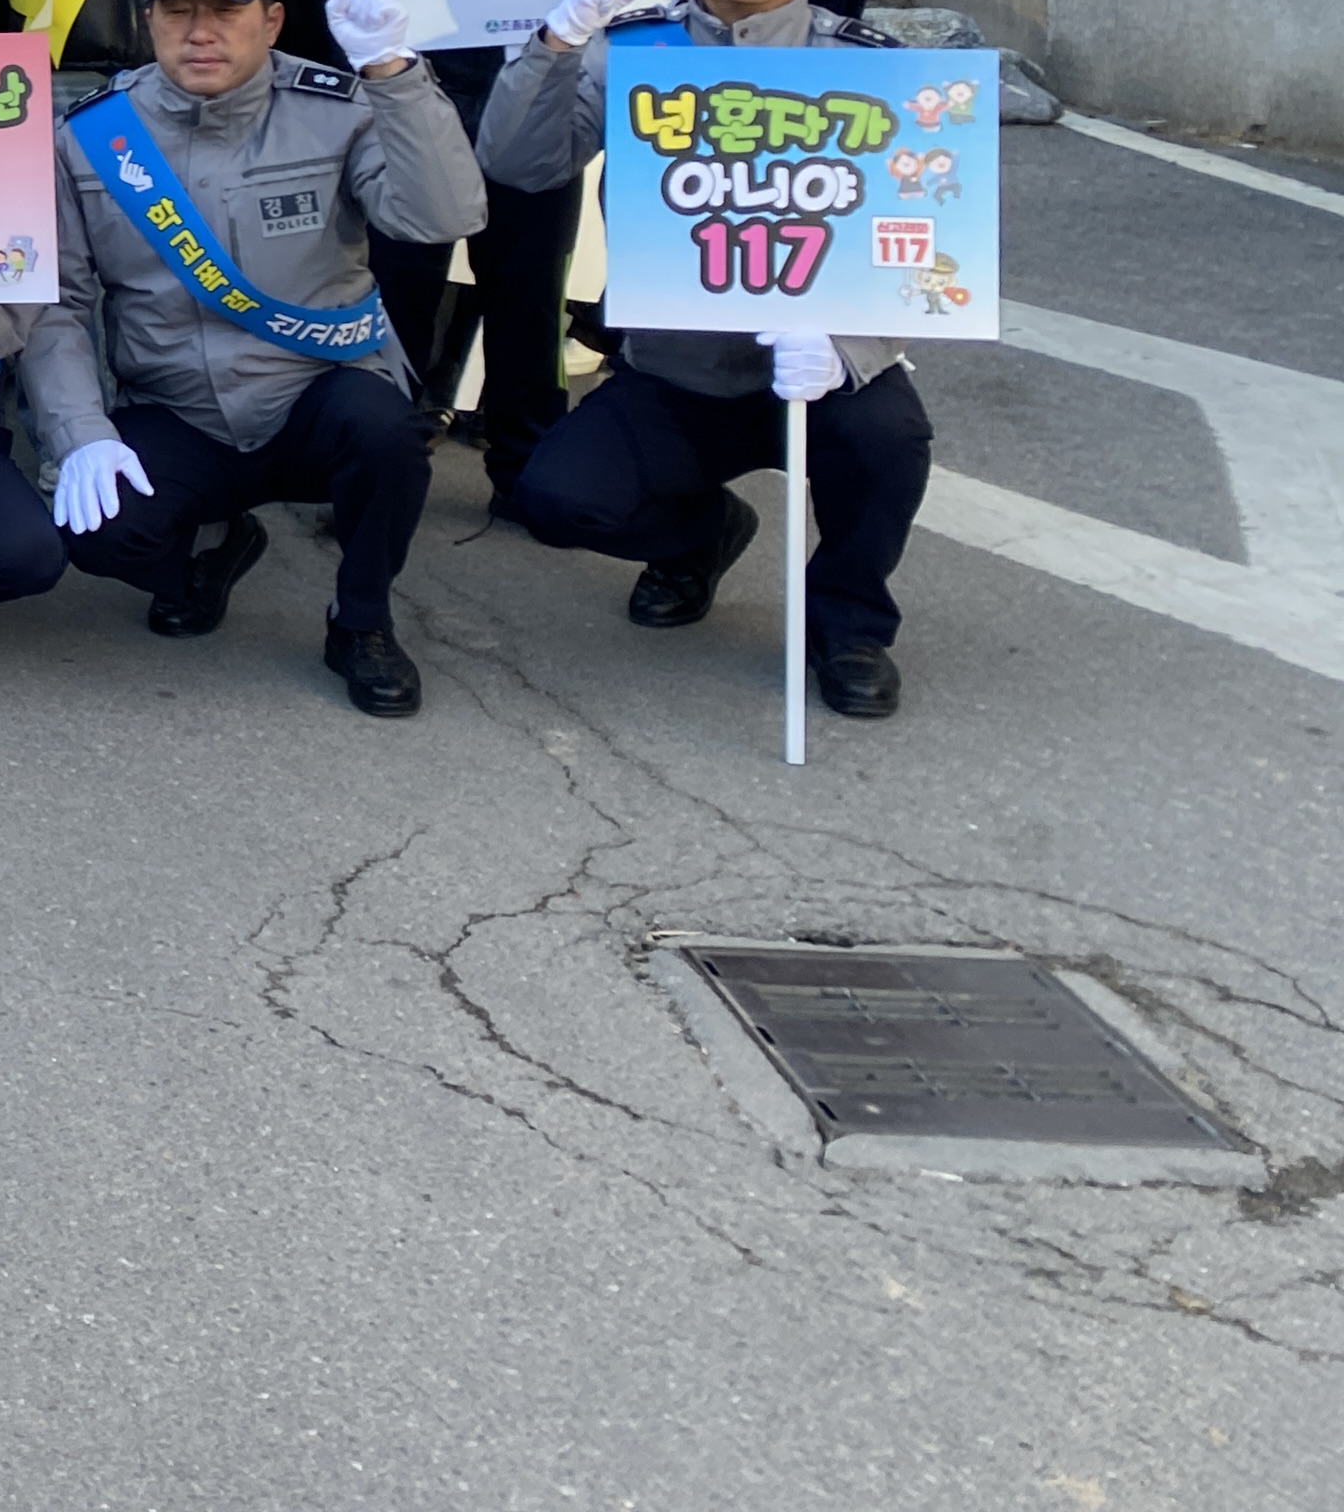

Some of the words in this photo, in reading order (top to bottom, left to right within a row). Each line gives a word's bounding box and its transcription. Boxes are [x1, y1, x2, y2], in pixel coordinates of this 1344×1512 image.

[635, 91, 697, 151] 넌
[708, 88, 893, 154] 혼자가
[668, 160, 858, 212] 아니야
[267, 215, 319, 232] POLICE
[697, 222, 828, 289] 117
[877, 237, 930, 264] 117
